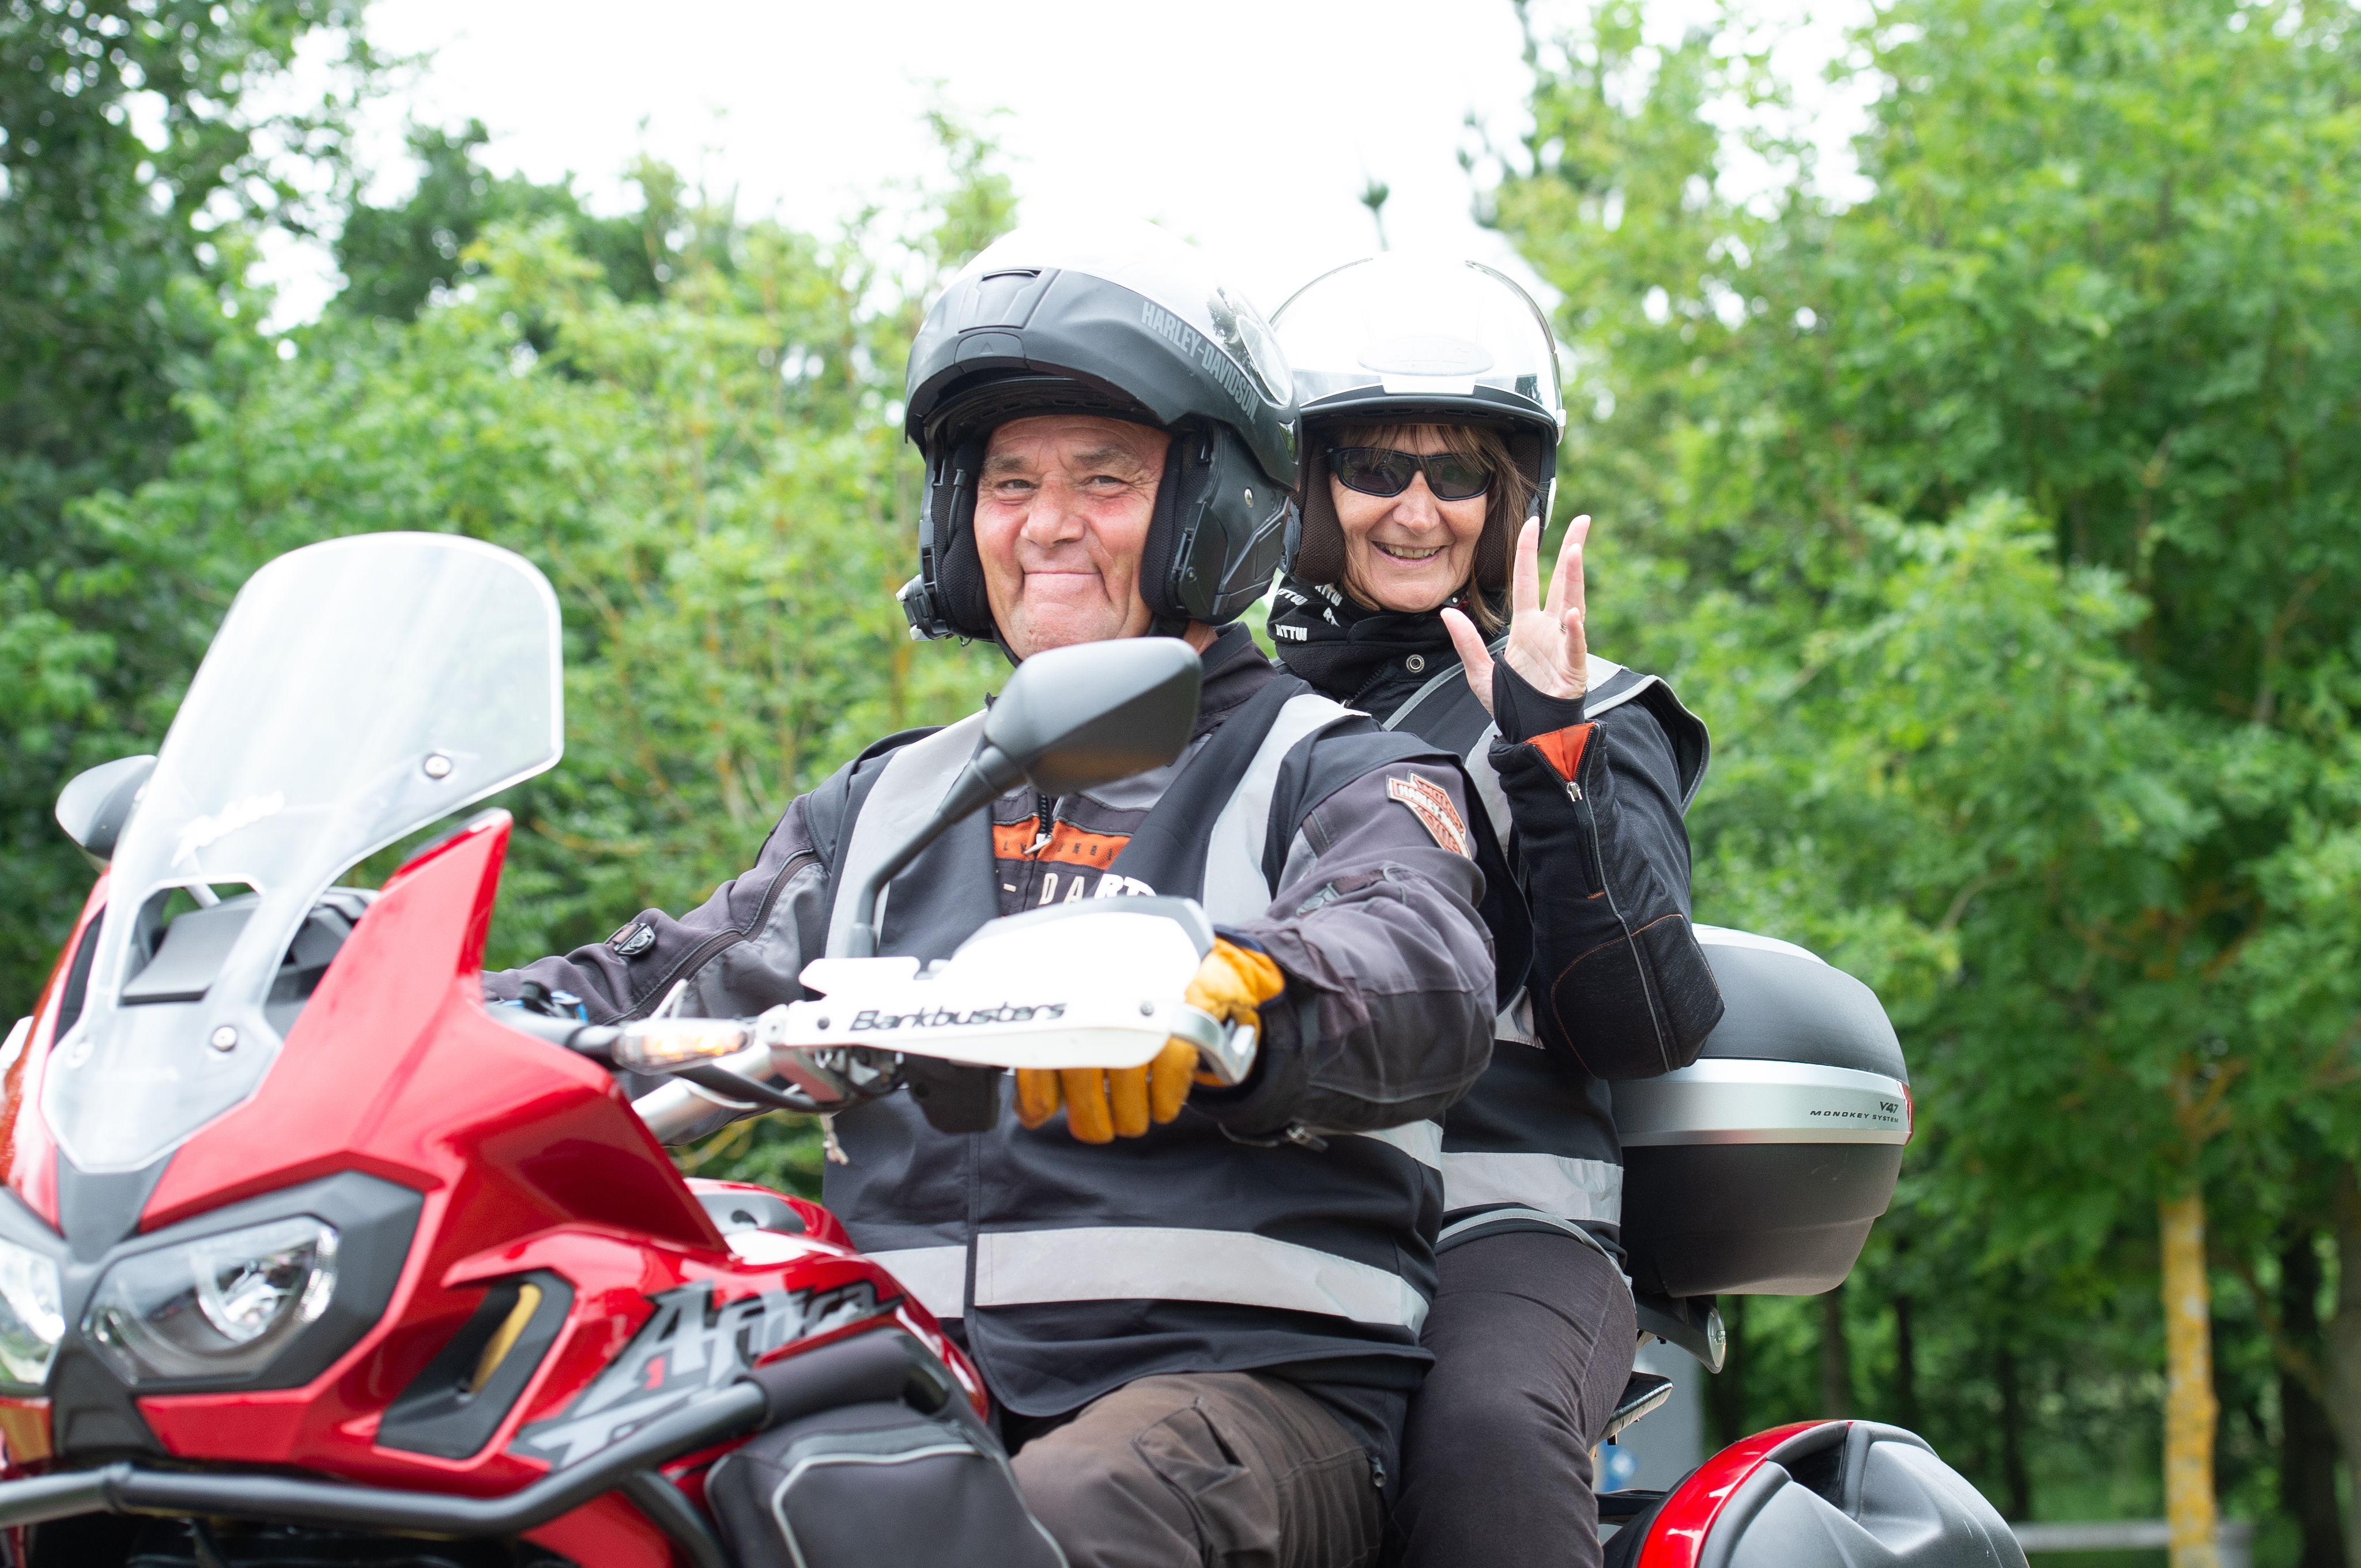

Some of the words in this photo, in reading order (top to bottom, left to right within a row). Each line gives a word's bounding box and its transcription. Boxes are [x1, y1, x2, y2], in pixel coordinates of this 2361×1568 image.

[1141, 300, 1259, 424] HARLEY-DAVIDSON
[849, 1002, 1067, 1031] Barkbusters
[1810, 1110, 1869, 1119] MONOKEY
[1872, 1114, 1899, 1123] SYSTEM
[1880, 1101, 1899, 1114] V47
